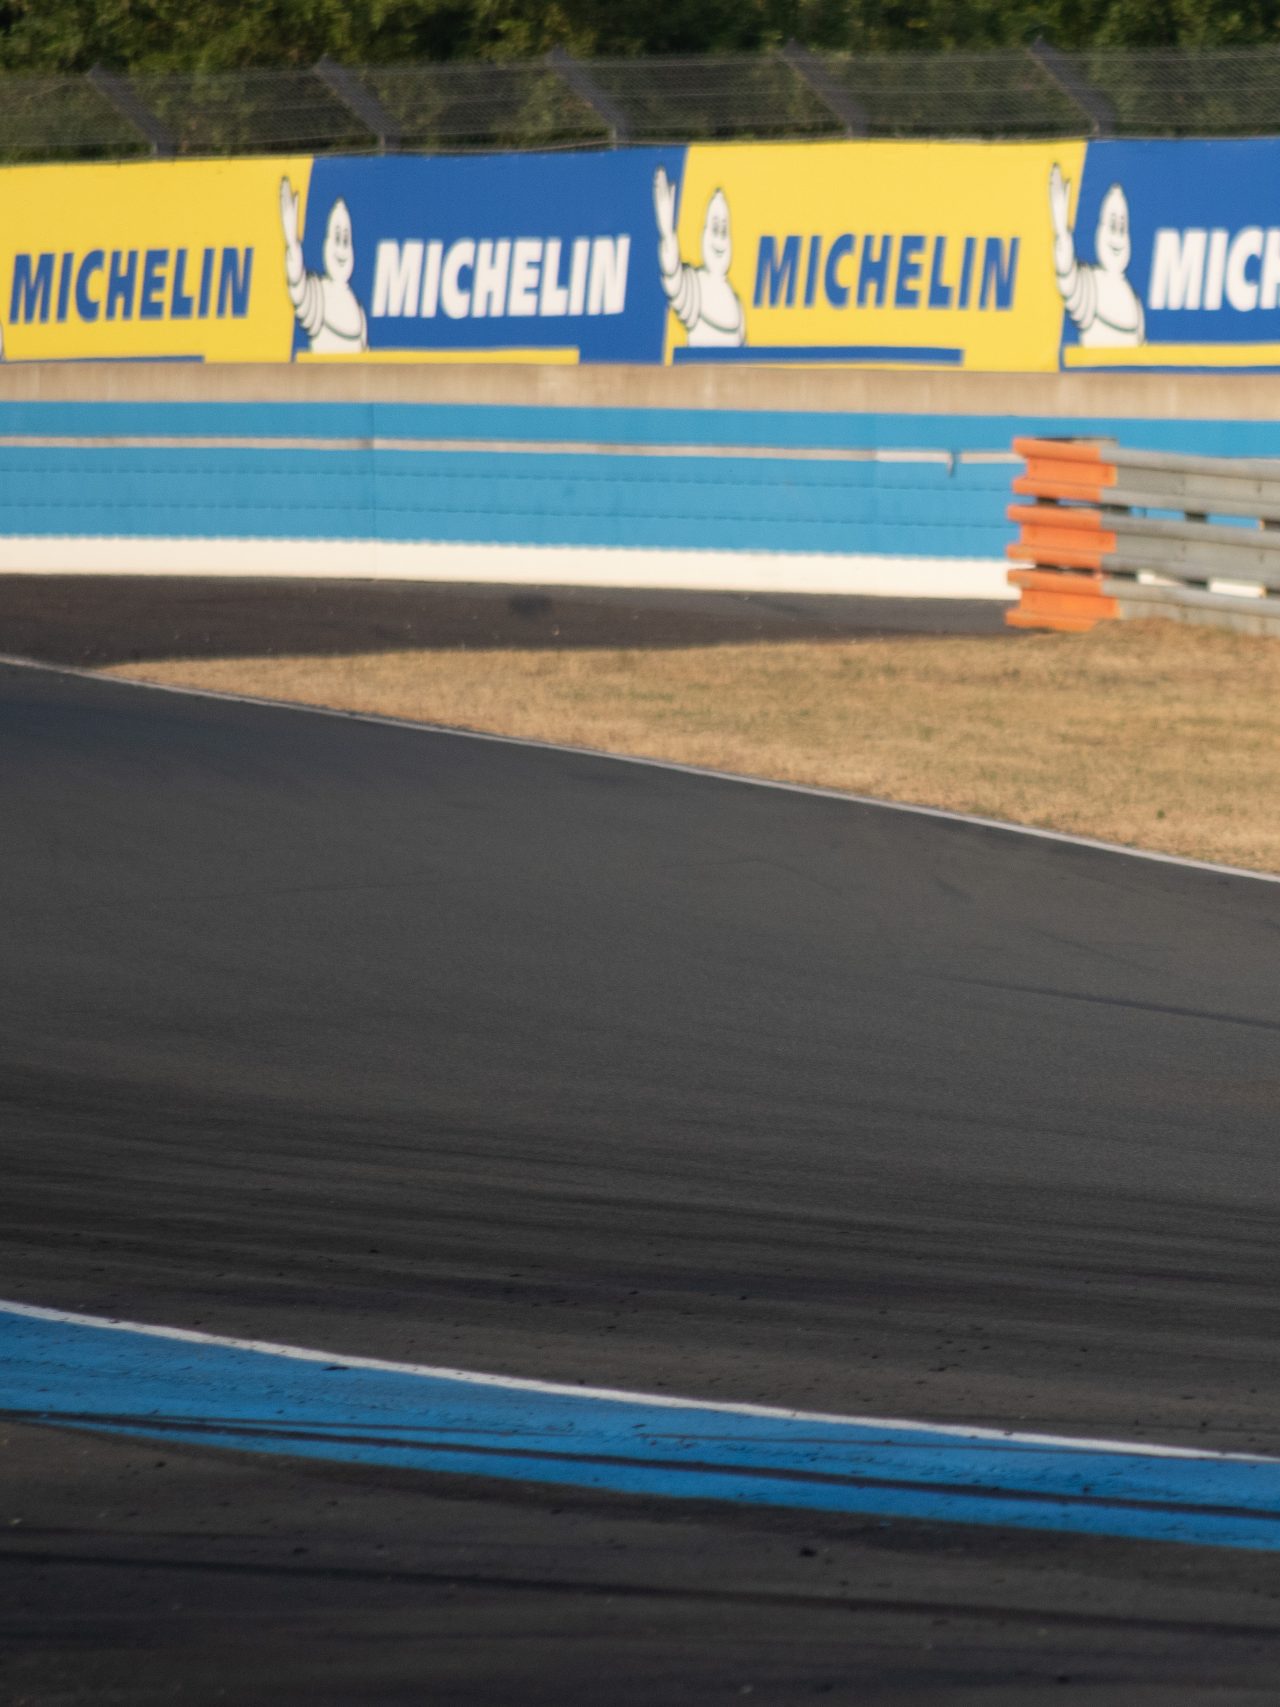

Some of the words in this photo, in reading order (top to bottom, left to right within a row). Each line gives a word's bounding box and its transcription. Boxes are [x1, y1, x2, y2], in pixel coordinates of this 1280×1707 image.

[10, 247, 253, 324] MICHELIN
[371, 234, 630, 319] MICHELIN
[752, 234, 1020, 311] MICHELIN
